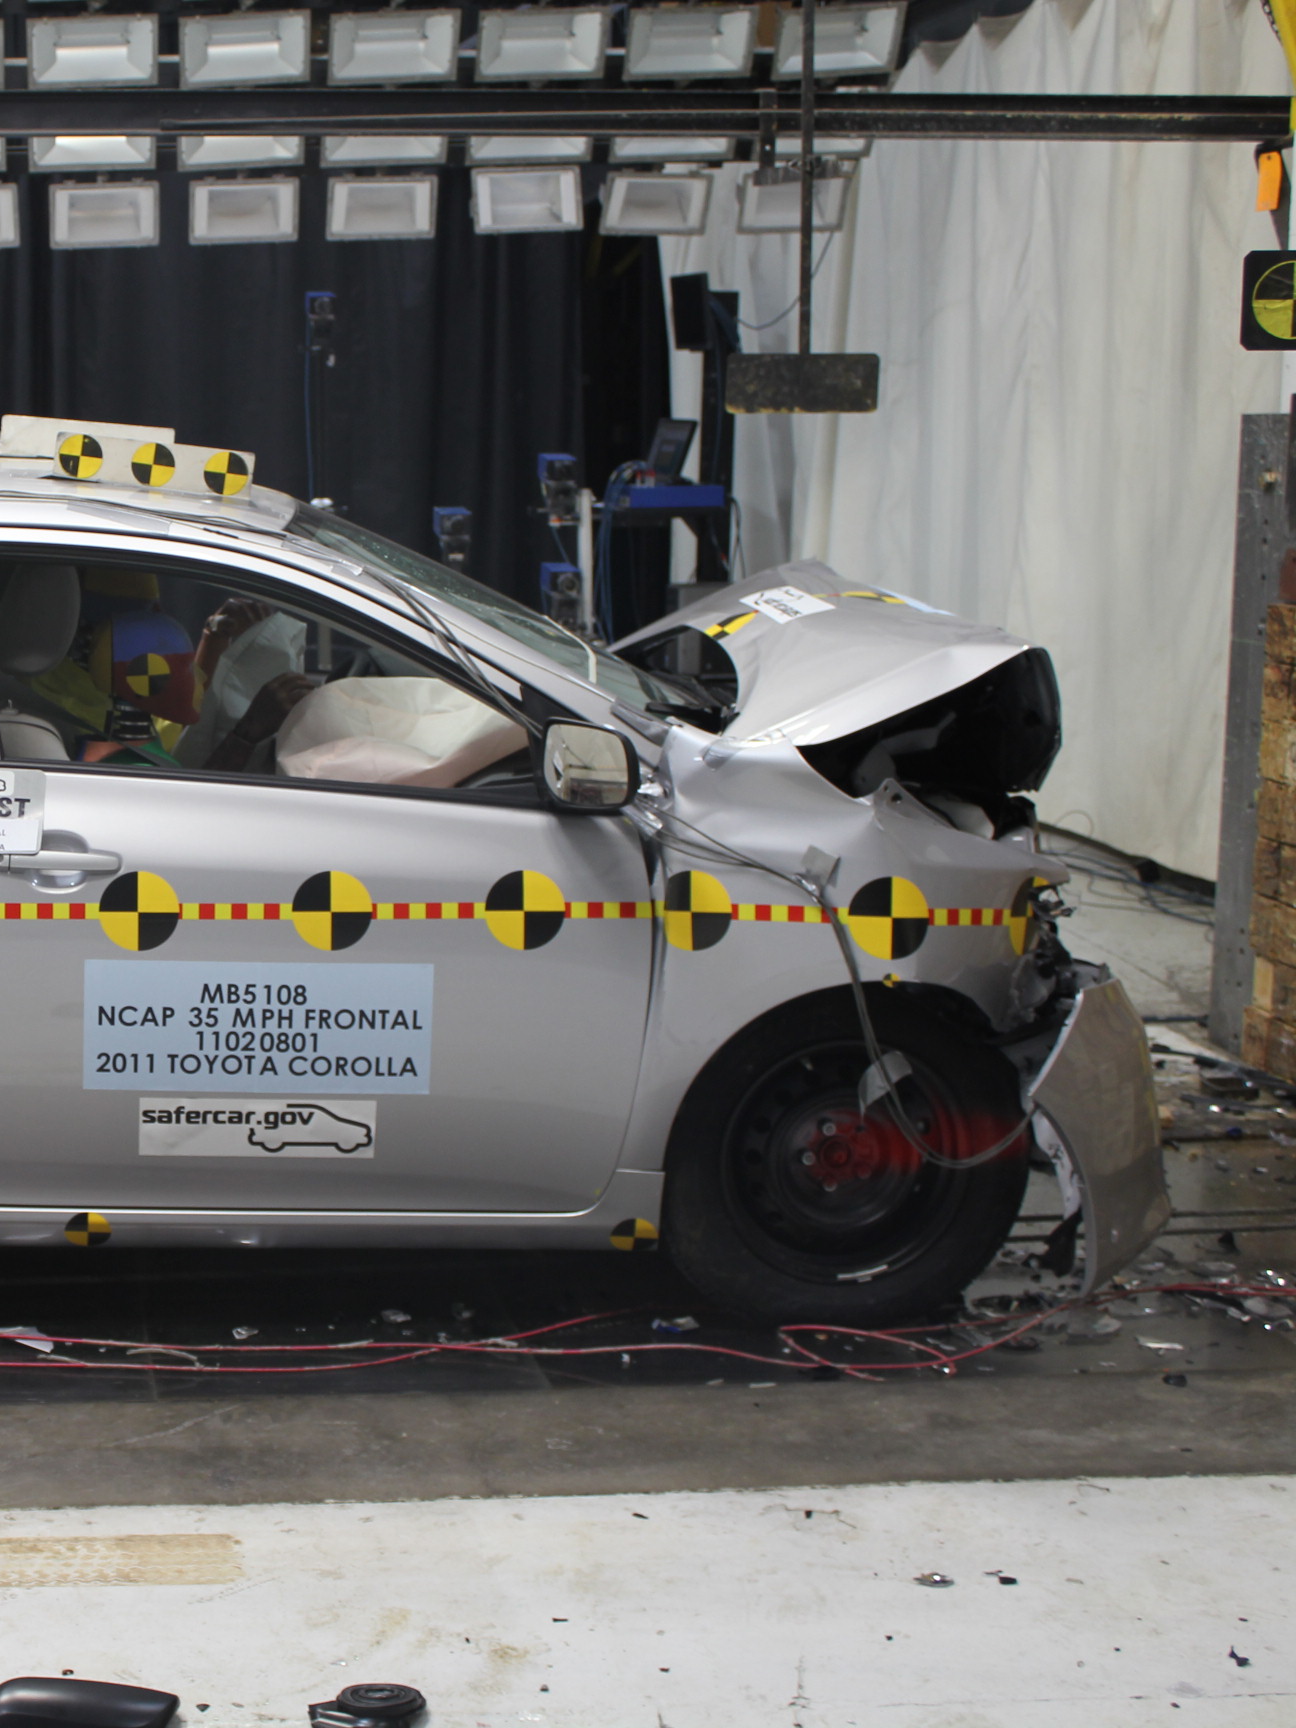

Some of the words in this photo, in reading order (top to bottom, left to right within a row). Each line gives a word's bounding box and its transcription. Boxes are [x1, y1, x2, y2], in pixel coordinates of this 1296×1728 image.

[200, 983, 308, 1005] MB5108
[97, 1006, 176, 1027] NCAP
[188, 1007, 219, 1028] 35
[232, 1008, 294, 1030] MPH
[304, 1009, 423, 1031] FRONTAL
[196, 1031, 320, 1053] 11020801
[96, 1053, 156, 1074] 2011
[167, 1054, 279, 1076] TOYOTA
[288, 1056, 419, 1078] COROLLA
[141, 1106, 315, 1130] safercar.gov
